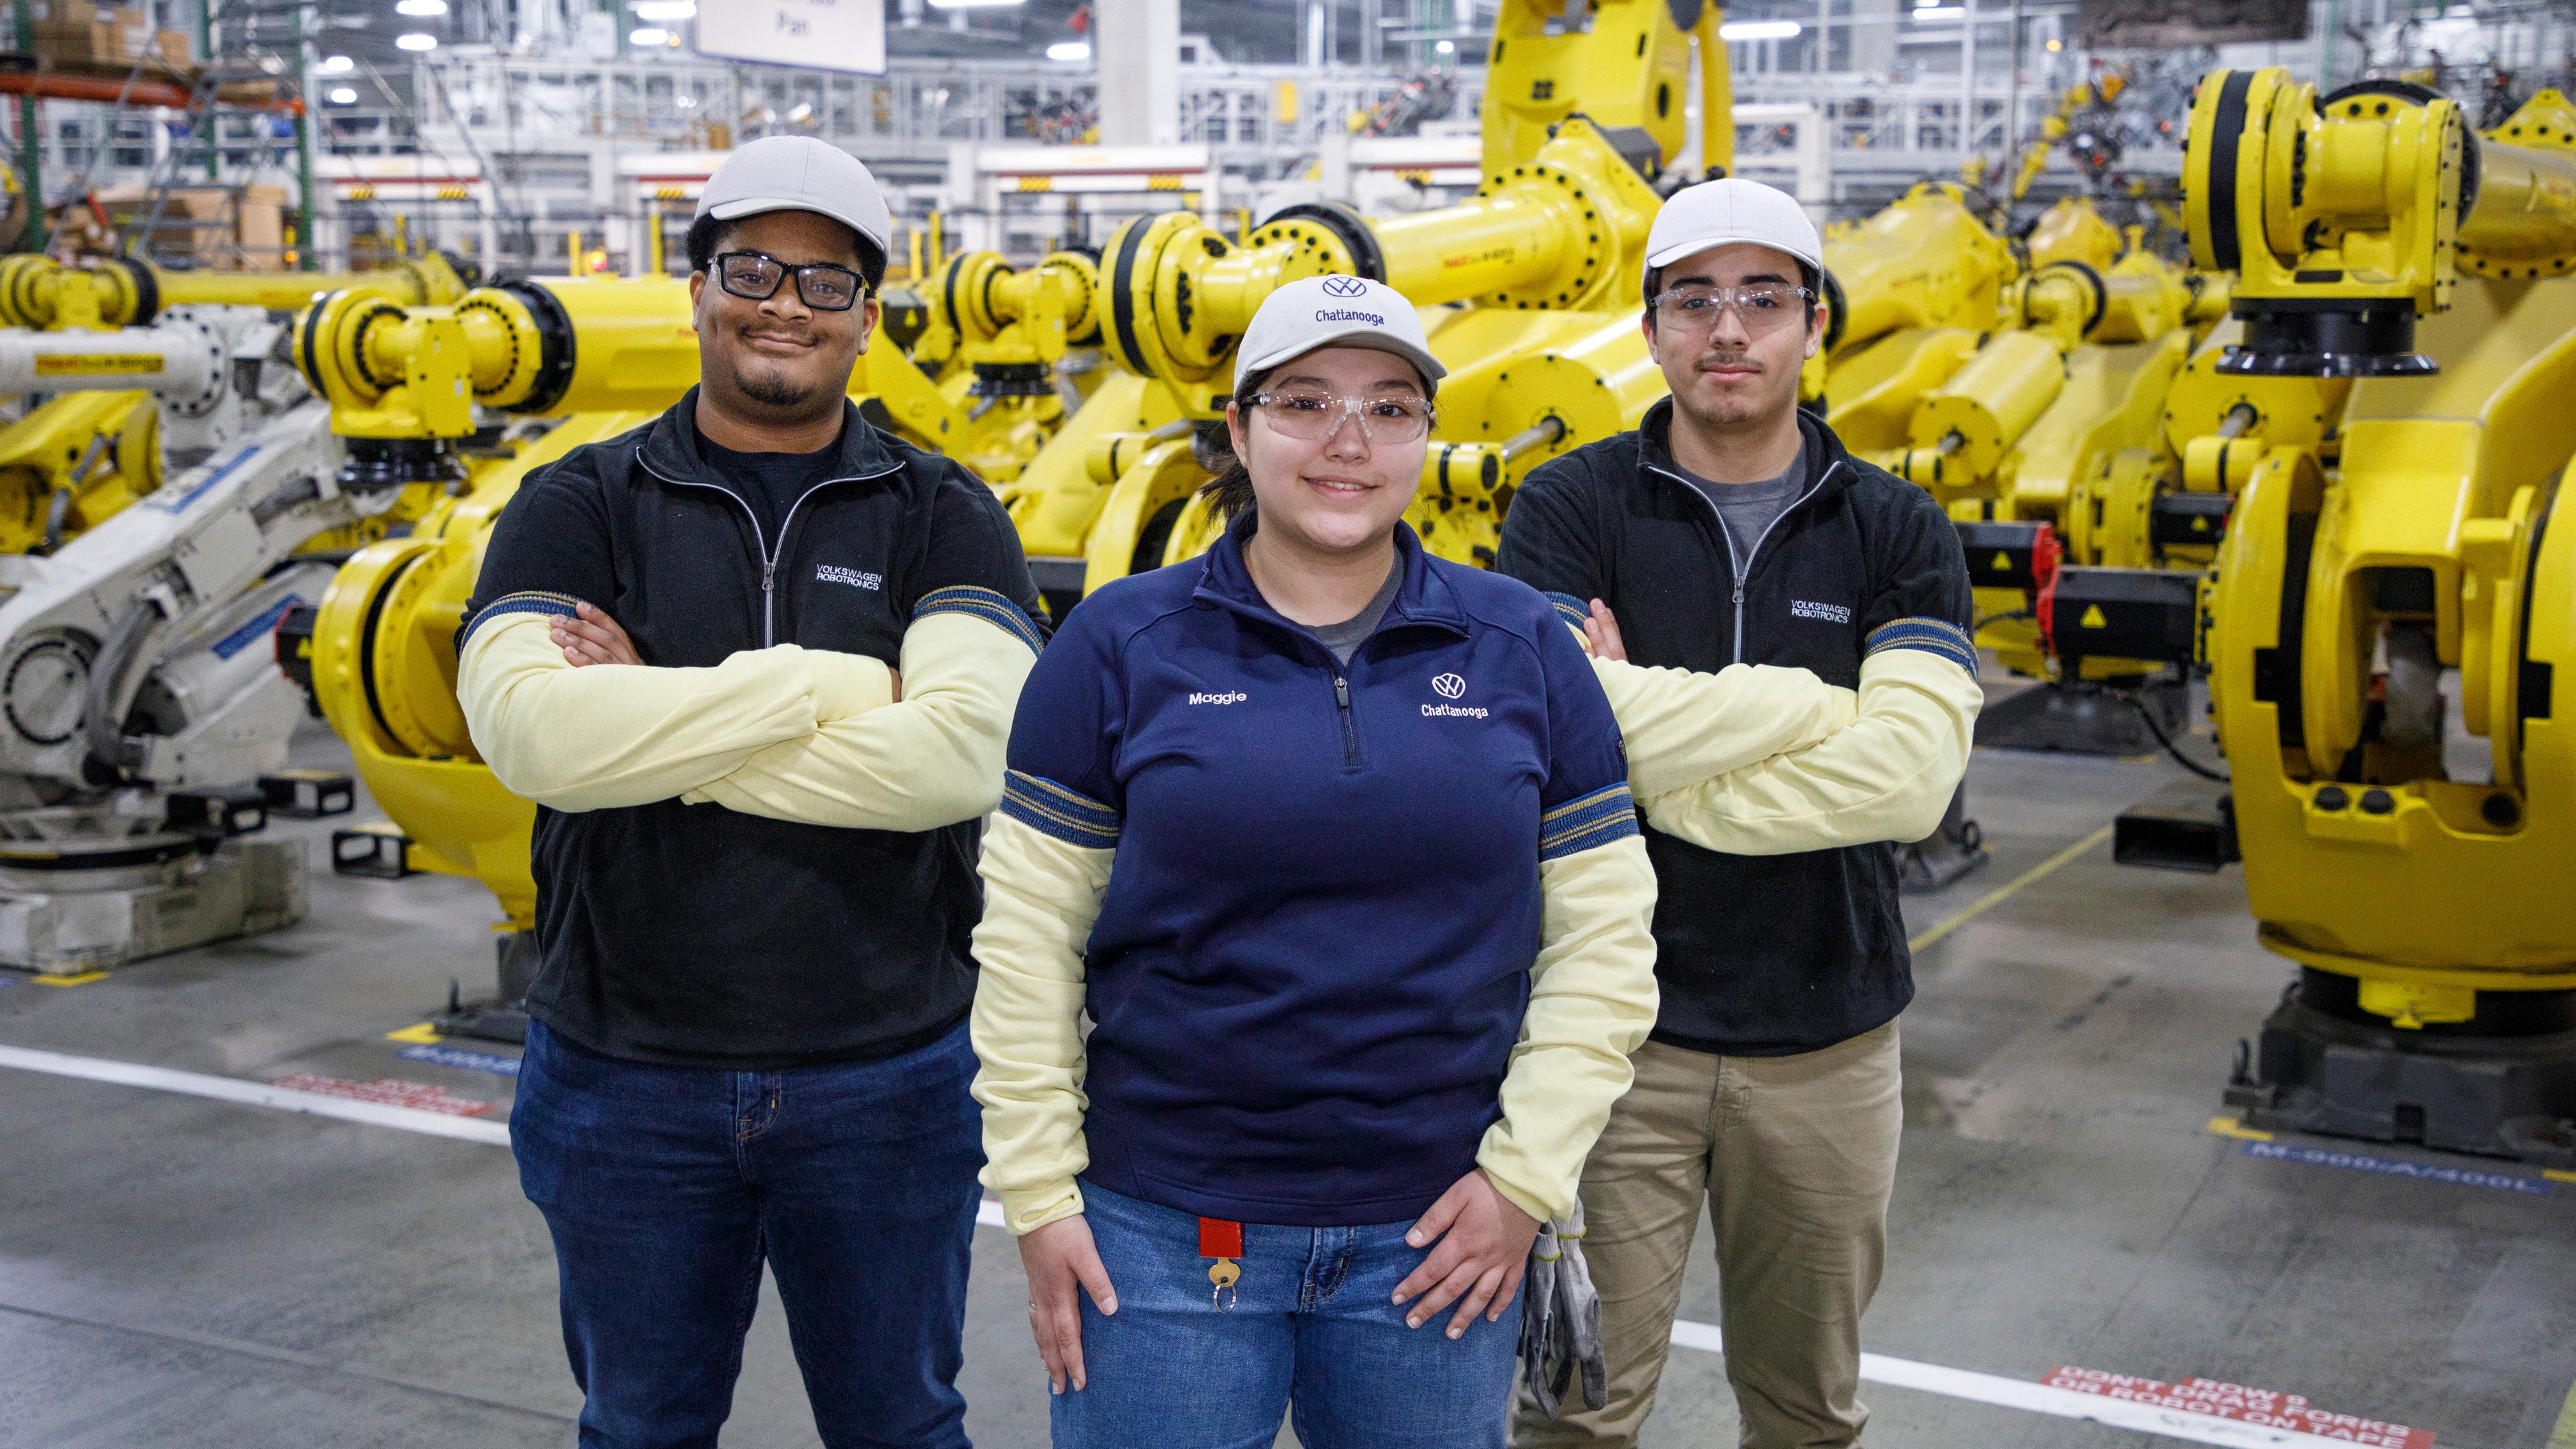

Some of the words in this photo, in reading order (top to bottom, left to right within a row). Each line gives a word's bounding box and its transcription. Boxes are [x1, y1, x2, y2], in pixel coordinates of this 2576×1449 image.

[1316, 309, 1385, 326] Chattanooga
[816, 564, 882, 583] VOLKSWAGEN
[816, 572, 879, 590] ROBOTRONICS
[1791, 599, 1850, 616] VOLKSWAGEN
[1791, 608, 1847, 624] ROBOTRONICS
[1189, 690, 1247, 705] Maggie
[1421, 704, 1489, 719] Chattanooga
[2059, 1365, 2168, 1393] DON'T
[2171, 1385, 2275, 1411] DRAG
[2284, 1406, 2410, 1438] FORKS
[2050, 1377, 2102, 1394] OR
[2108, 1387, 2234, 1418] ROBOT
[2243, 1411, 2300, 1430] ON
[2305, 1421, 2407, 1449] TAPE
